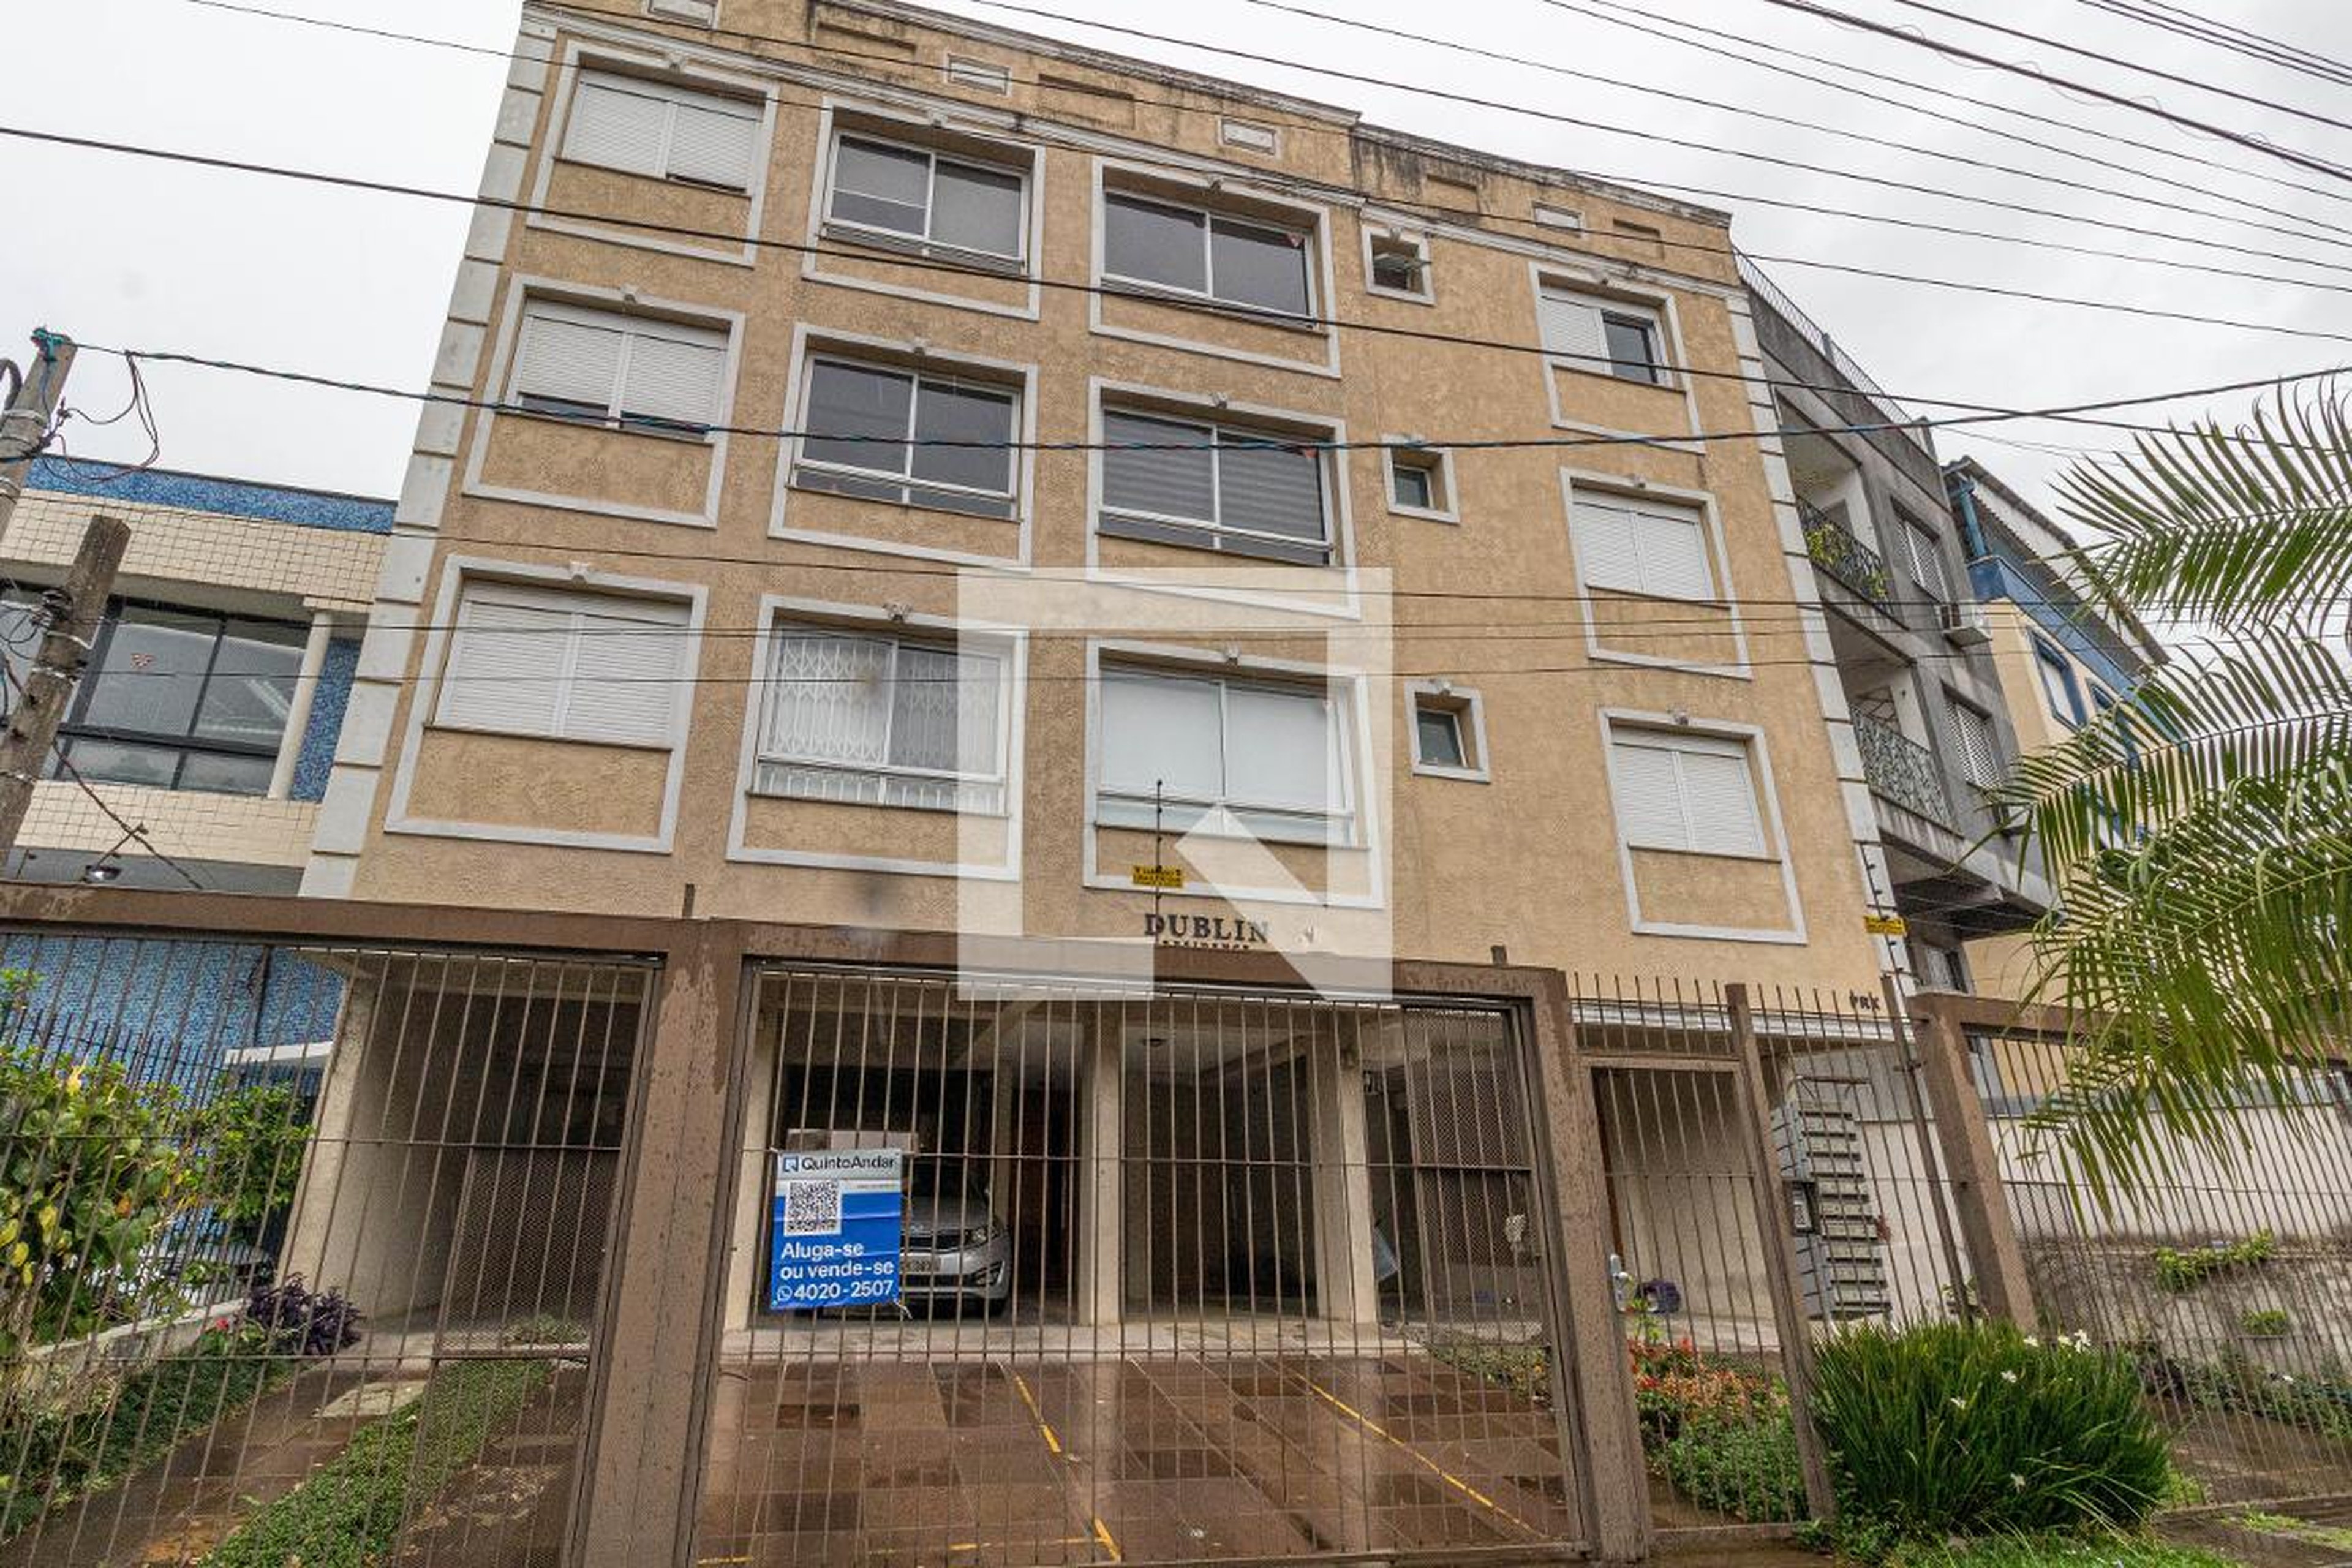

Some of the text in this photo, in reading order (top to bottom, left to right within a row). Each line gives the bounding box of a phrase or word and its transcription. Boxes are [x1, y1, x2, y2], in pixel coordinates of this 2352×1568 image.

[1144, 913, 1269, 943] DUBLIN
[801, 1155, 895, 1170] QuintoAndar
[782, 1242, 864, 1261] Aluga-se
[780, 1266, 804, 1280] ou
[808, 1261, 895, 1278] vende-se
[794, 1280, 895, 1300] 4020-2507
